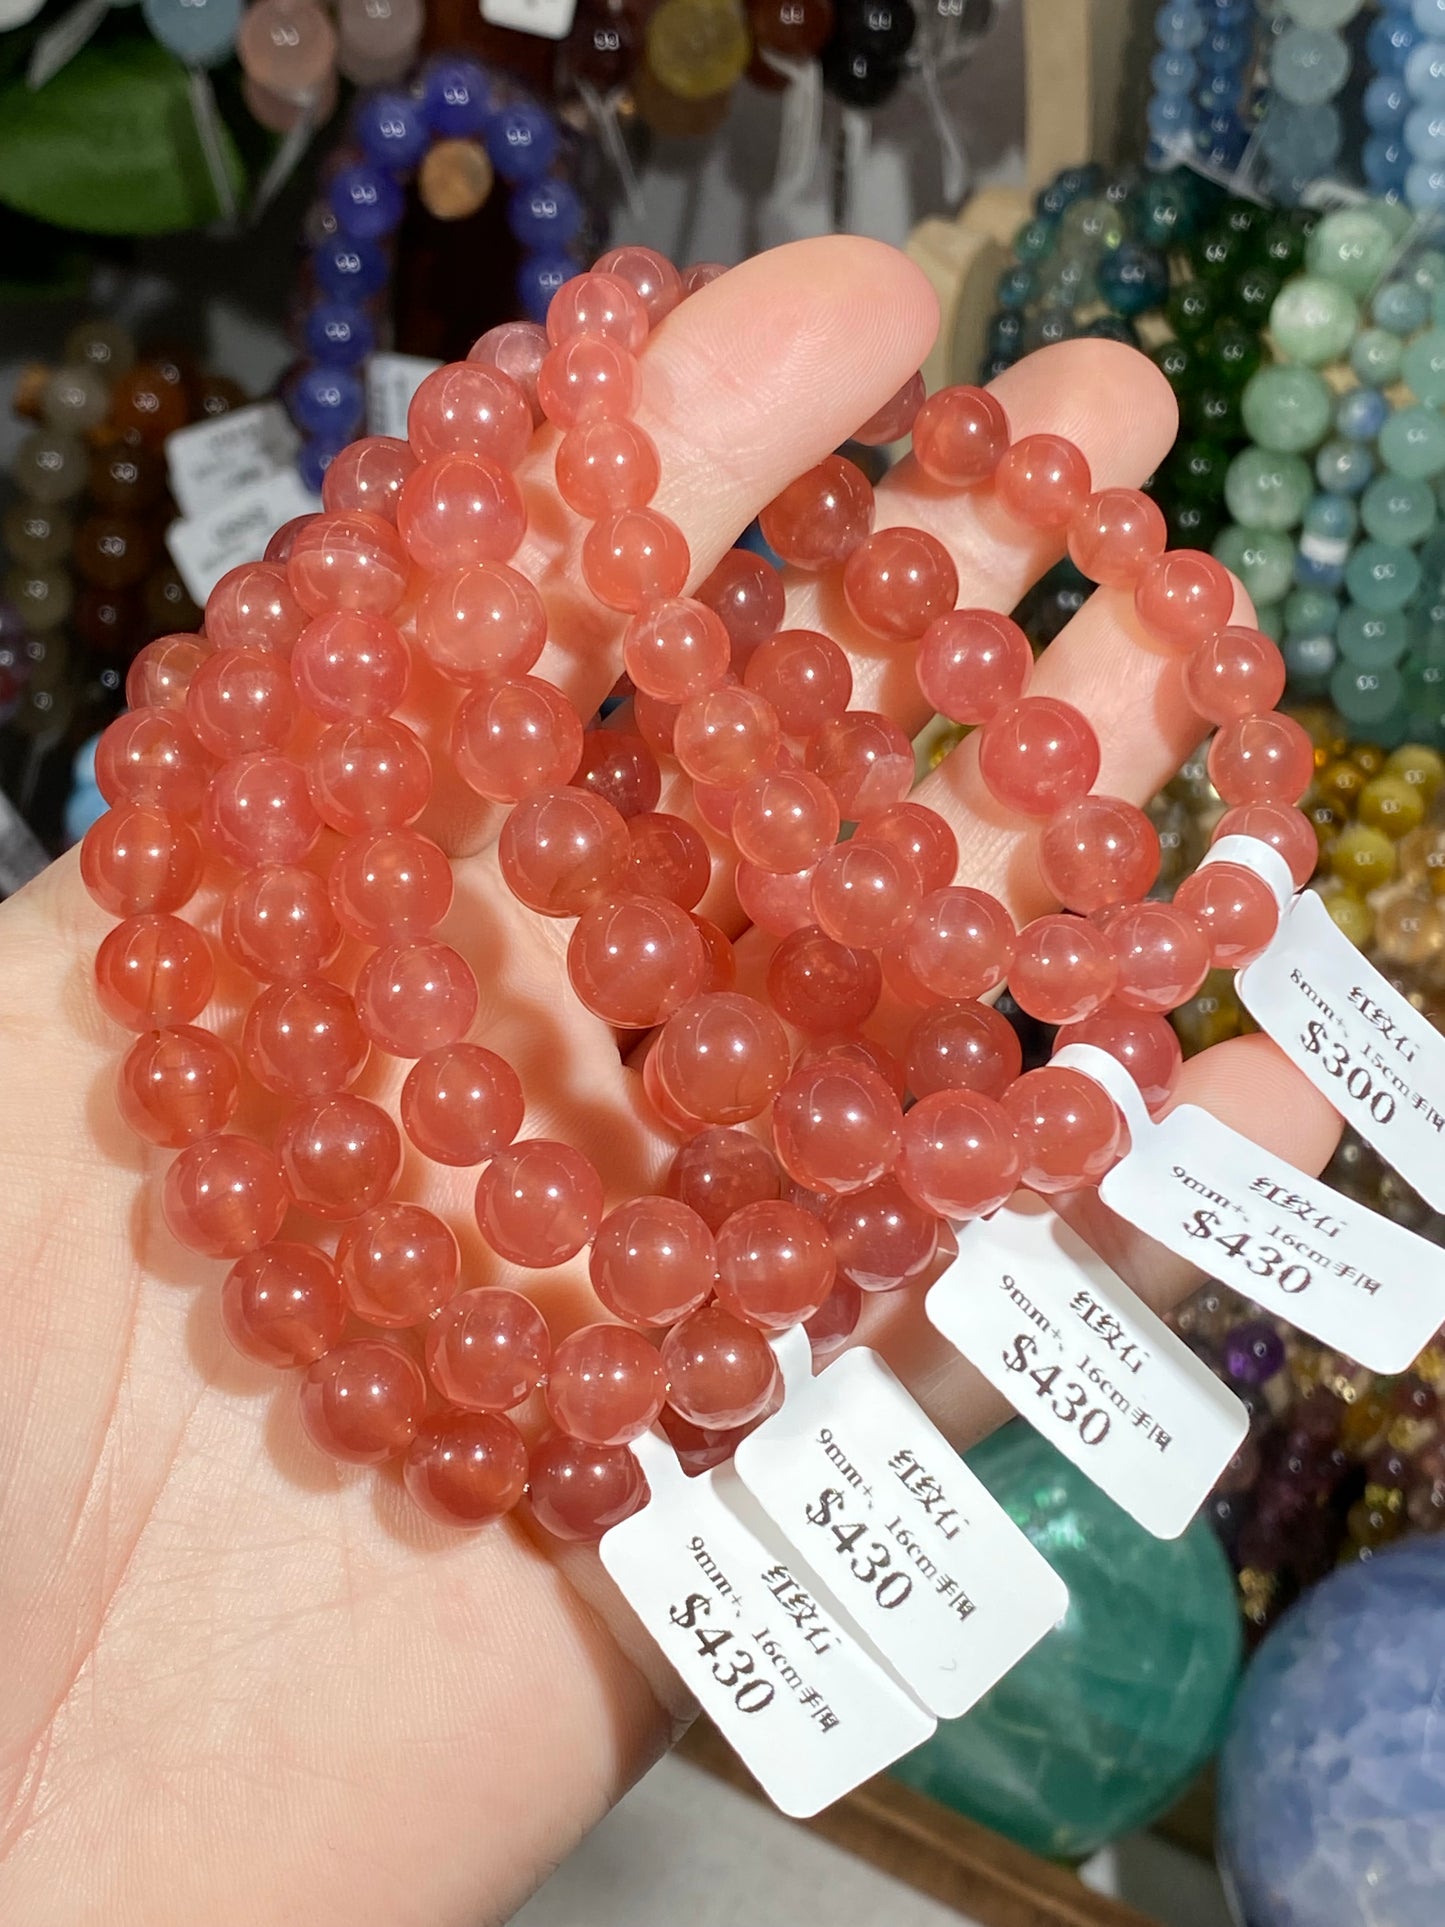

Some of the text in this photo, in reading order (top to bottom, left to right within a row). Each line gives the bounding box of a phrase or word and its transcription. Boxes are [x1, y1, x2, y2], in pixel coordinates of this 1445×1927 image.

[1300, 1020, 1396, 1124] $300
[1183, 1210, 1312, 1293] $430
[1003, 1334, 1111, 1445] $430
[806, 1488, 912, 1609] $430
[669, 1593, 775, 1713] $430
